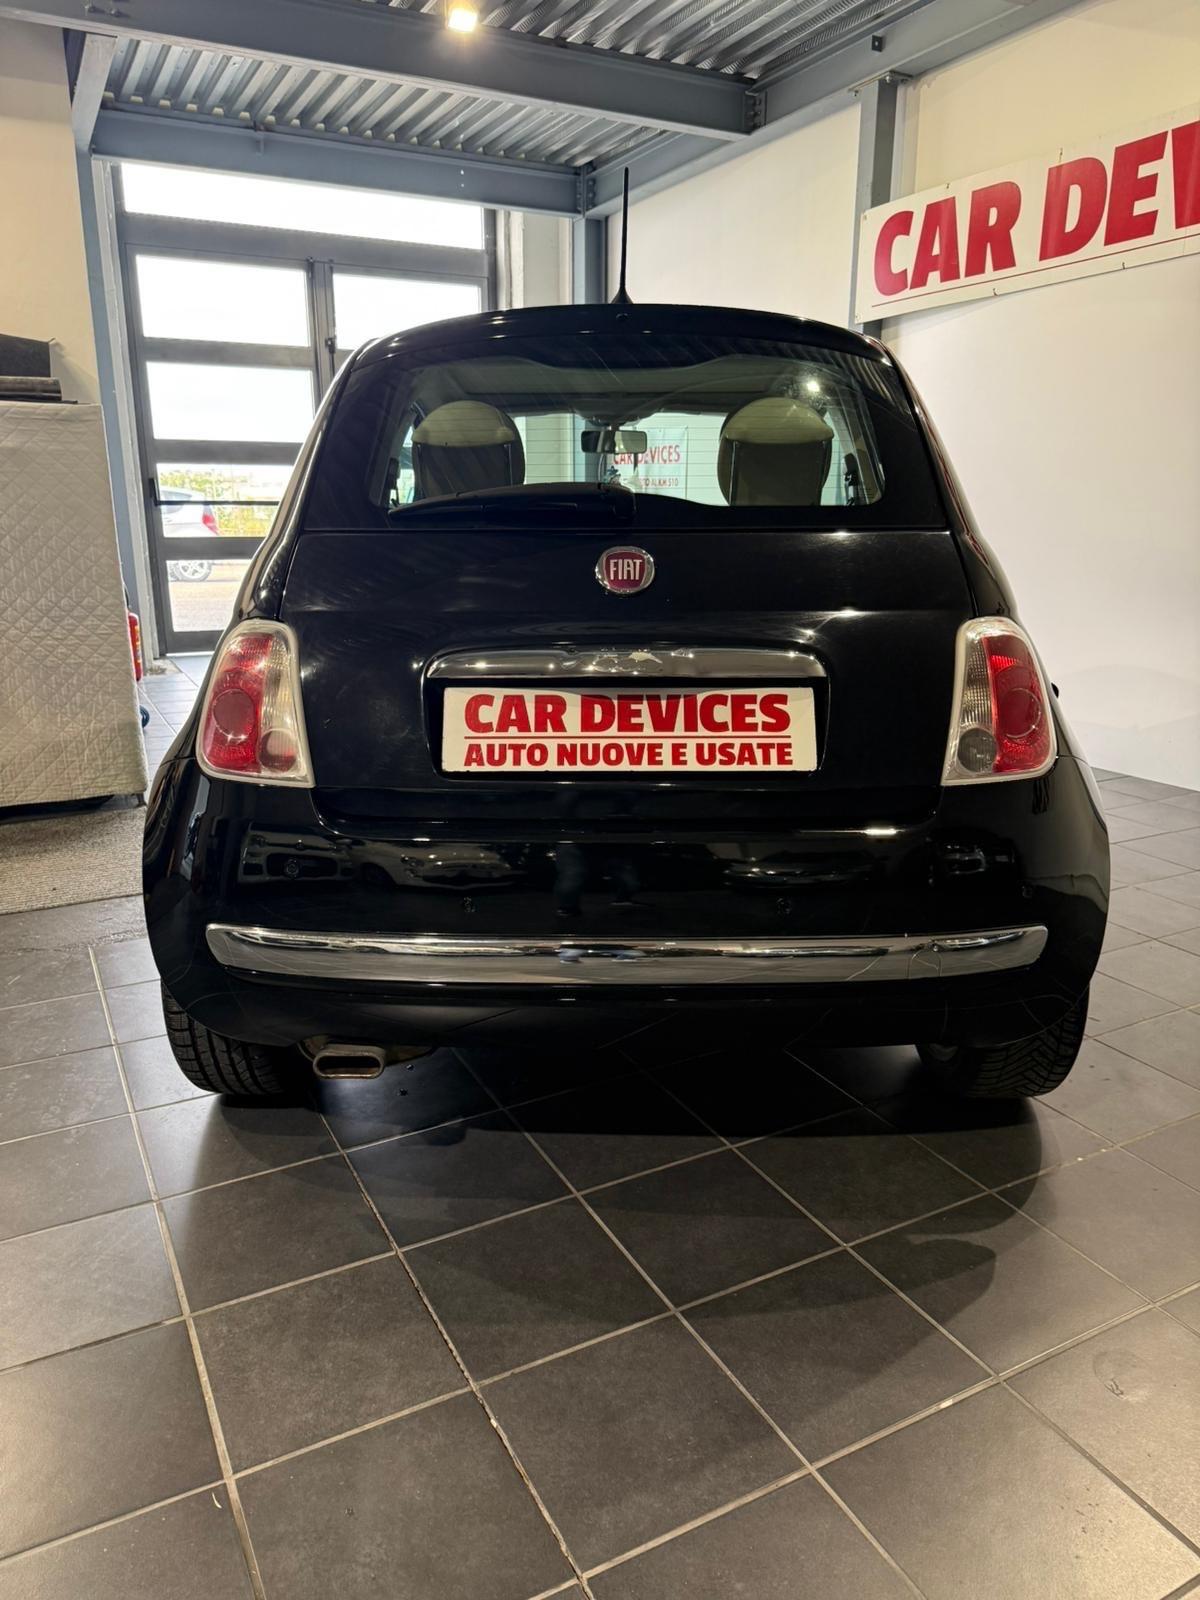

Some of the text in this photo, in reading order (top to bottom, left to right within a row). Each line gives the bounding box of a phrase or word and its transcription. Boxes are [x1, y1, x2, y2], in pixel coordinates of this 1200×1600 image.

[874, 180, 1022, 296] CAR
[609, 559, 643, 580] FIAT
[464, 694, 791, 733] CAR DEVICES
[464, 742, 793, 766] AUTO NUOVE E USATE
